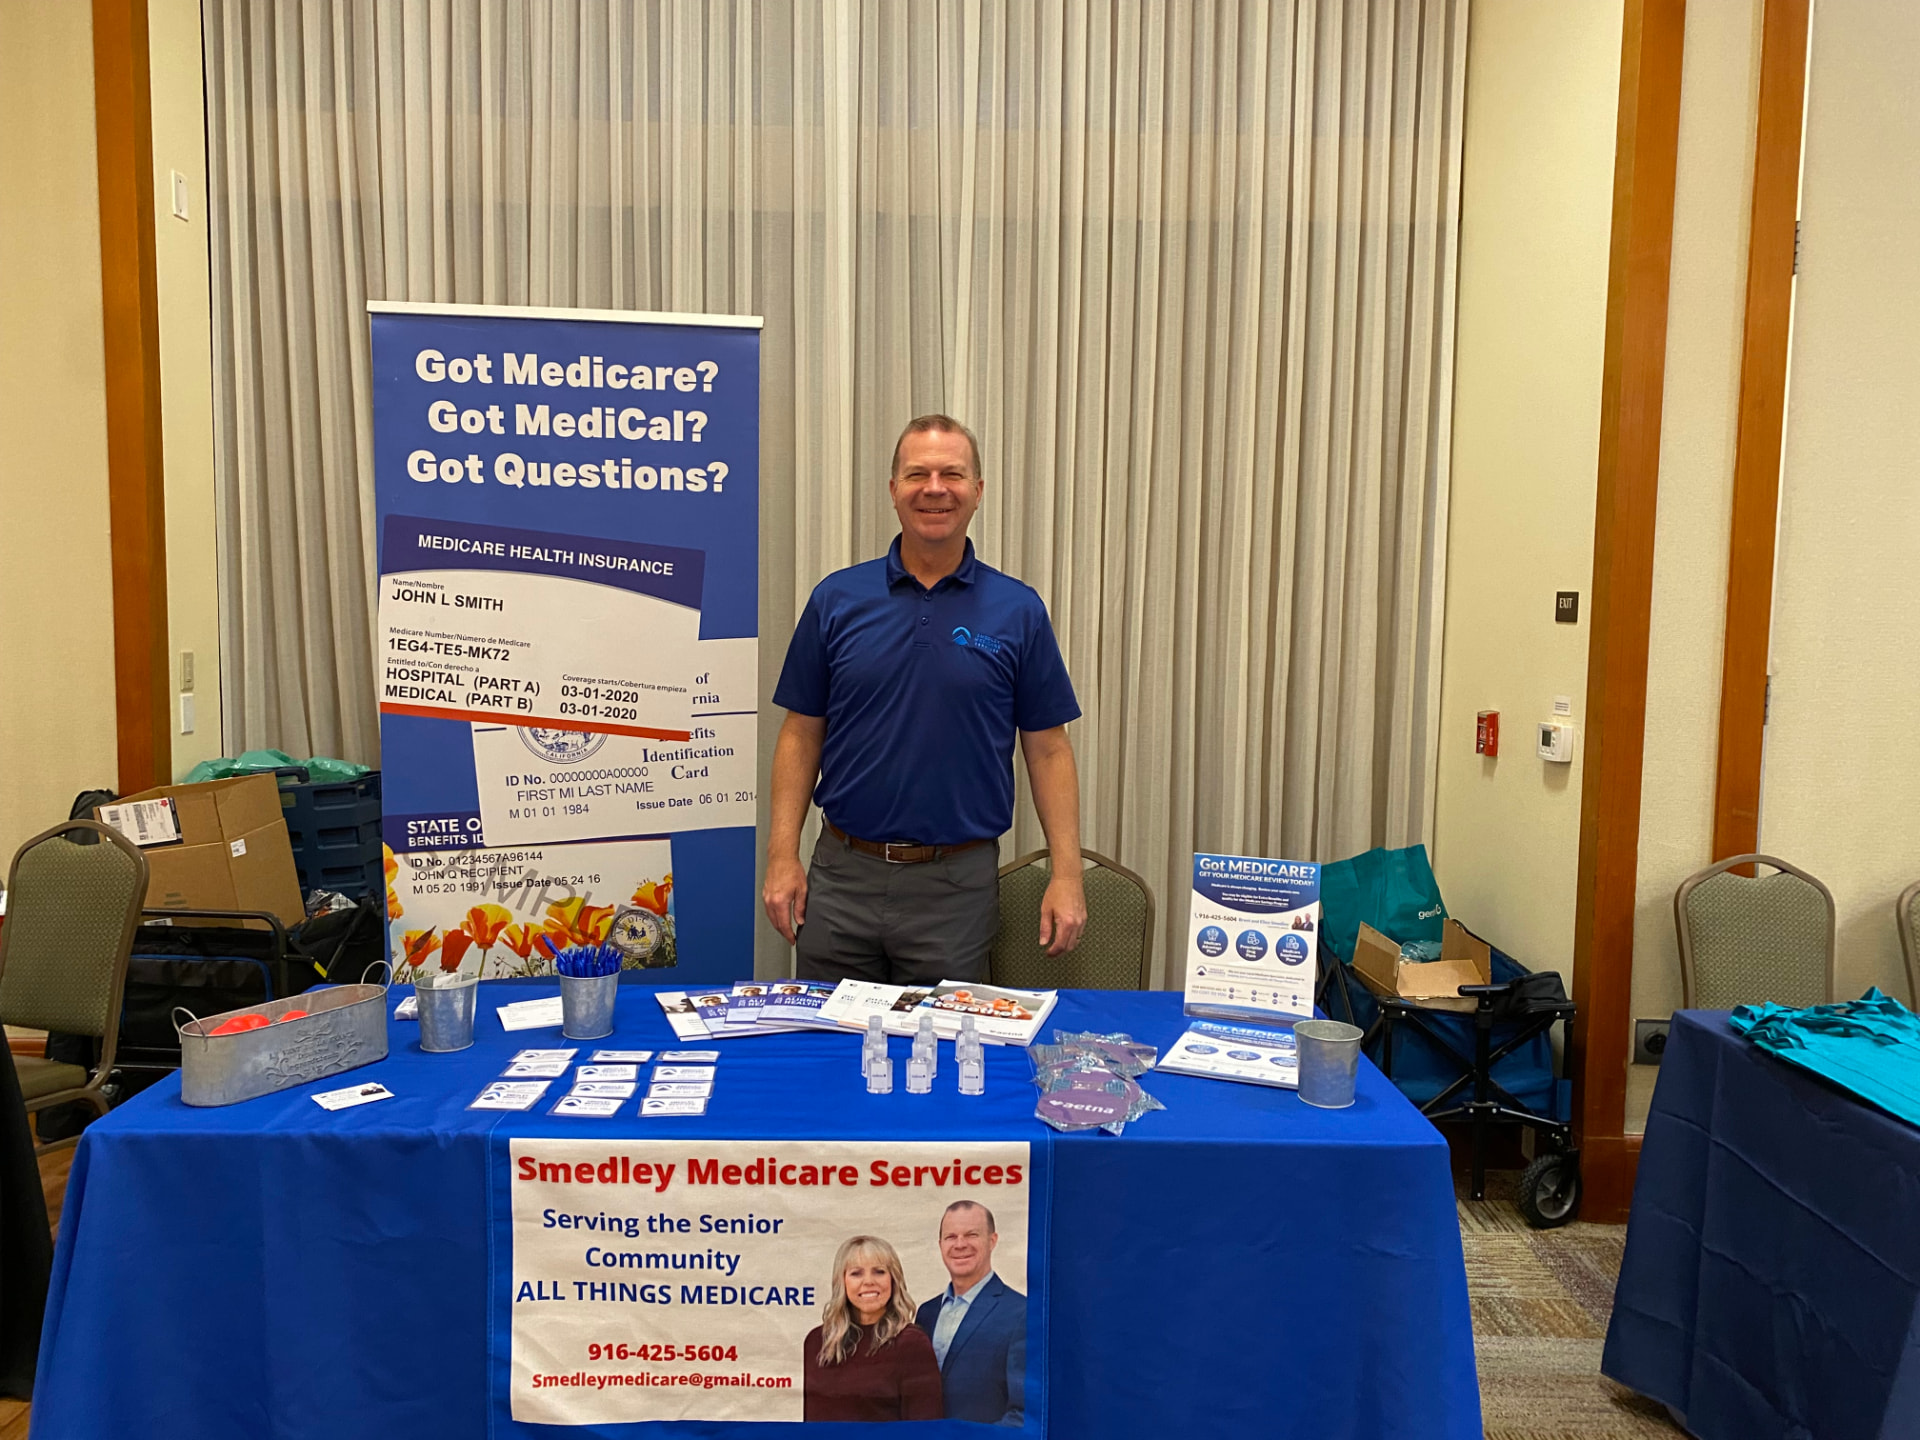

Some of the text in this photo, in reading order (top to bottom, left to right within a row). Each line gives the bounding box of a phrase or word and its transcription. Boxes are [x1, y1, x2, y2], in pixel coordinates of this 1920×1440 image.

[415, 349, 719, 393] Got Medicare?
[428, 400, 708, 442] Got MediCal?
[406, 449, 729, 492] Got Questions?
[417, 534, 674, 576] MEDICARE HEALTH INSURANCE
[392, 578, 445, 591] Name/Nombre
[392, 588, 504, 612] JOHN L SMITH
[1559, 597, 1573, 609] EXIT
[389, 626, 424, 637] Medicare
[487, 636, 497, 645] de
[498, 638, 531, 649] Medicare
[388, 637, 510, 662] 1EG4-TE5-MK72
[387, 657, 416, 667] Entitled
[418, 660, 443, 670] to/Con
[444, 664, 474, 673] derecho
[386, 667, 541, 697] HOSPITAL (PART A)
[562, 673, 688, 694] Coverage starts/Cobertura empieza
[695, 672, 710, 685] of
[385, 685, 533, 713] MEDICAL (PART B)
[561, 685, 639, 704] 03-01-2020
[560, 702, 637, 721] 03-01-2020
[642, 745, 735, 763] Identification
[505, 775, 520, 787] ID
[523, 774, 546, 785] No.
[671, 764, 709, 780] Card
[517, 781, 654, 802] FIRST MI LAST NAME
[636, 799, 665, 810] Issue
[668, 797, 693, 808] Date
[699, 793, 713, 804] 06
[716, 792, 729, 803] 01
[509, 803, 590, 819] M 01 01 1984
[407, 817, 481, 835] STATE O
[408, 834, 468, 847] BENEFITS
[411, 851, 543, 869] ID No. 01234567A96144
[1199, 857, 1316, 879] Got MEDICARE?
[412, 865, 524, 881] JOHN Q RECIPIENT
[1230, 873, 1263, 882] MEDICARE
[413, 874, 601, 895] M 05 20 1991 Issue Date 05 24 16
[1063, 1102, 1114, 1115] aetna
[517, 1156, 1024, 1193] Smedley Medicare Services
[542, 1208, 784, 1238] Serving the Senior
[584, 1246, 741, 1276] Community
[516, 1280, 816, 1306] ALL THINGS MEDICARE
[588, 1342, 738, 1363] 916-425-5604
[532, 1372, 793, 1391] Smedleymedicare@gmail.com
